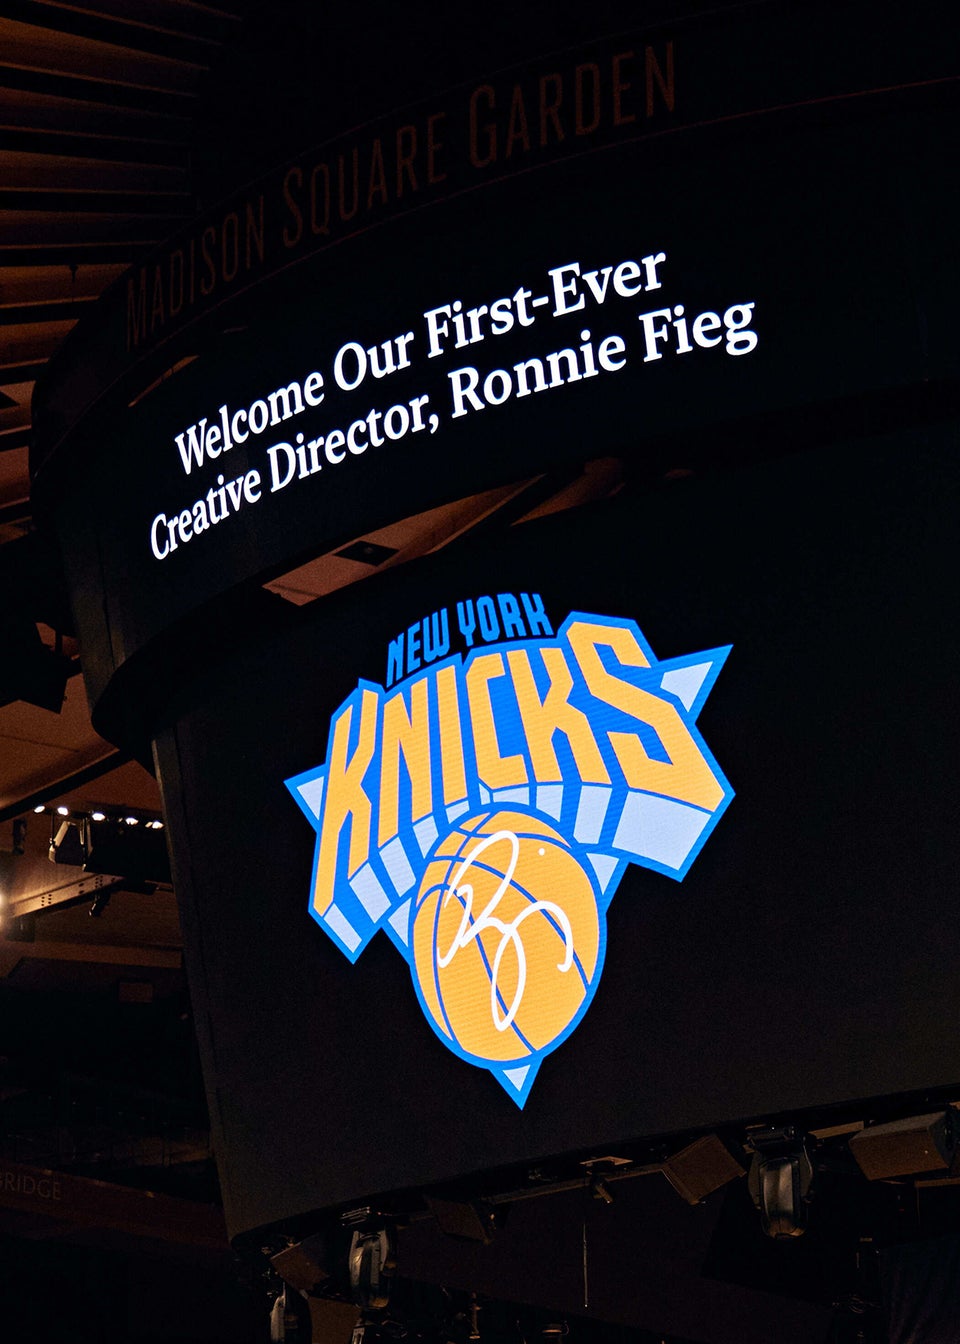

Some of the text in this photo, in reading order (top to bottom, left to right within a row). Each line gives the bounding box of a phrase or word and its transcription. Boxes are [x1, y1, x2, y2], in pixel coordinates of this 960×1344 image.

[126, 40, 676, 352] MADISON SQUARE GARDEN
[150, 301, 759, 562] Creative Director, Ronnie Fieg
[174, 250, 668, 476] Welcome Our First-Ever
[386, 592, 554, 688] NEW YORK
[311, 619, 728, 919] KNICKS
[0, 1171, 62, 1201] RIDGE
